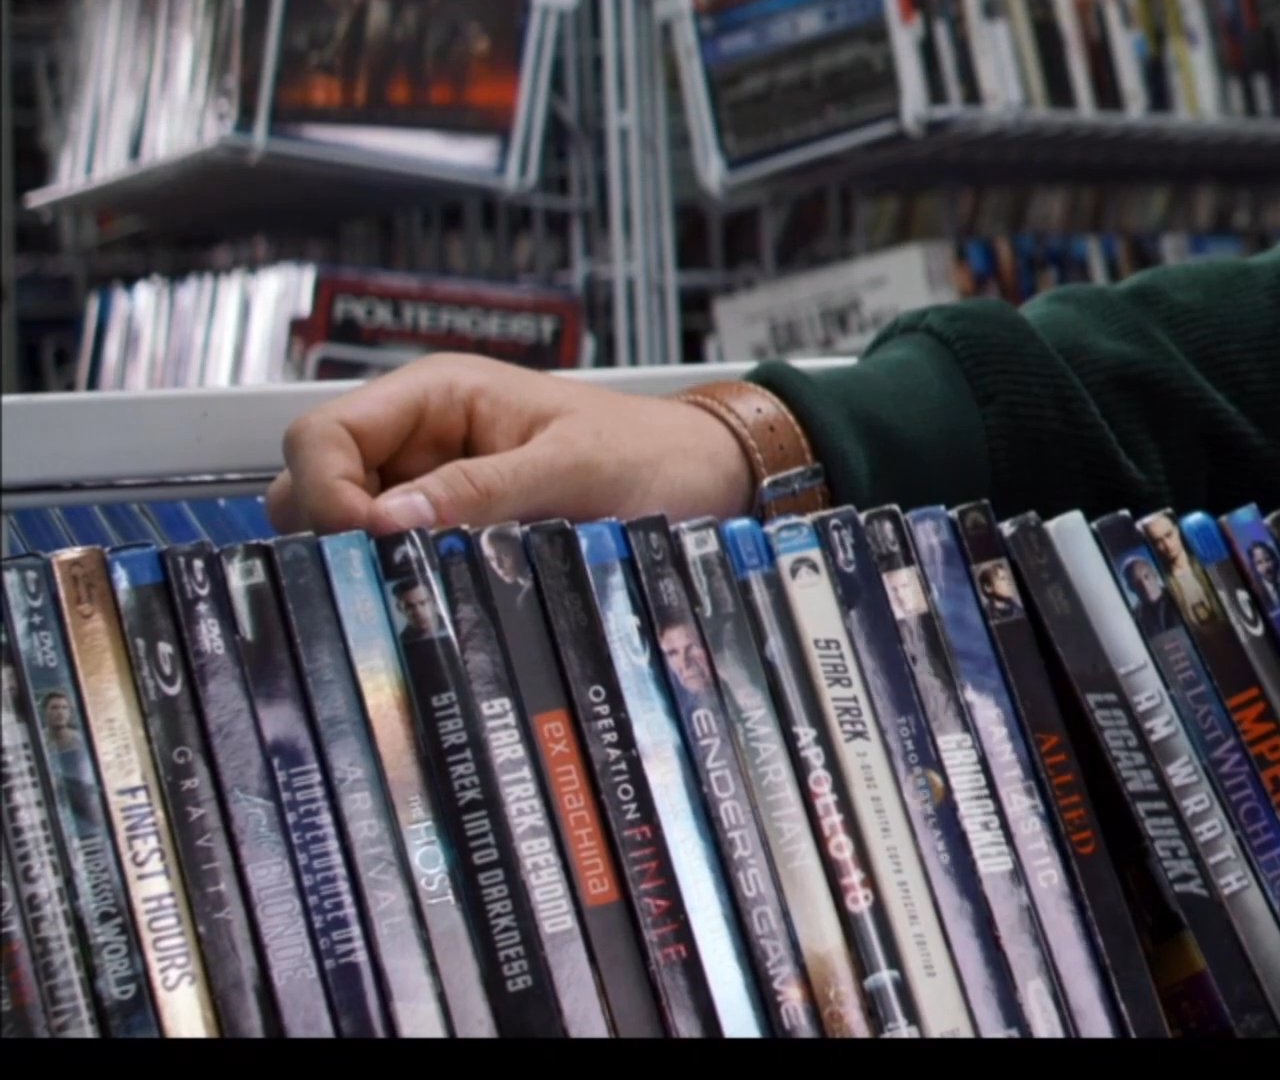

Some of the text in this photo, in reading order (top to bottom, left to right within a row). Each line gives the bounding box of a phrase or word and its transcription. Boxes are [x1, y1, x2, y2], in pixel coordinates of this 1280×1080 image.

[332, 290, 563, 342] POLTERGEIST
[542, 719, 570, 757] ex
[812, 632, 855, 694] STAR
[830, 690, 871, 747] TREK
[1162, 634, 1199, 684] THE
[1183, 682, 1229, 746] LAST
[169, 743, 235, 925] GRAVITY
[290, 761, 368, 968] INDEPENDENCE DAY
[339, 761, 403, 933] ARRIVAL
[404, 818, 457, 913] HOST
[428, 689, 533, 994] STAR TREK INTO DARKNESS
[480, 694, 573, 935] STAR TREK BEYOND
[584, 682, 689, 967] OPERATION FINALE
[688, 705, 768, 900] ENDER'S
[747, 901, 807, 1032] GAME
[737, 705, 815, 872] MARTIAN
[790, 720, 876, 918] APOLLO 18
[895, 714, 953, 866] TOMORROWLAND
[937, 726, 1014, 880] GRIDLOCKED
[1032, 725, 1102, 859] ALLIED
[1085, 683, 1211, 909] LOGAN LUCKY
[1133, 684, 1180, 746] AM
[1162, 752, 1249, 900] WRATH
[23, 886, 95, 1035] SEASON
[93, 916, 142, 1003] WORLD
[113, 781, 197, 993] FINEST HOURS
[247, 855, 317, 987] BLONDE
